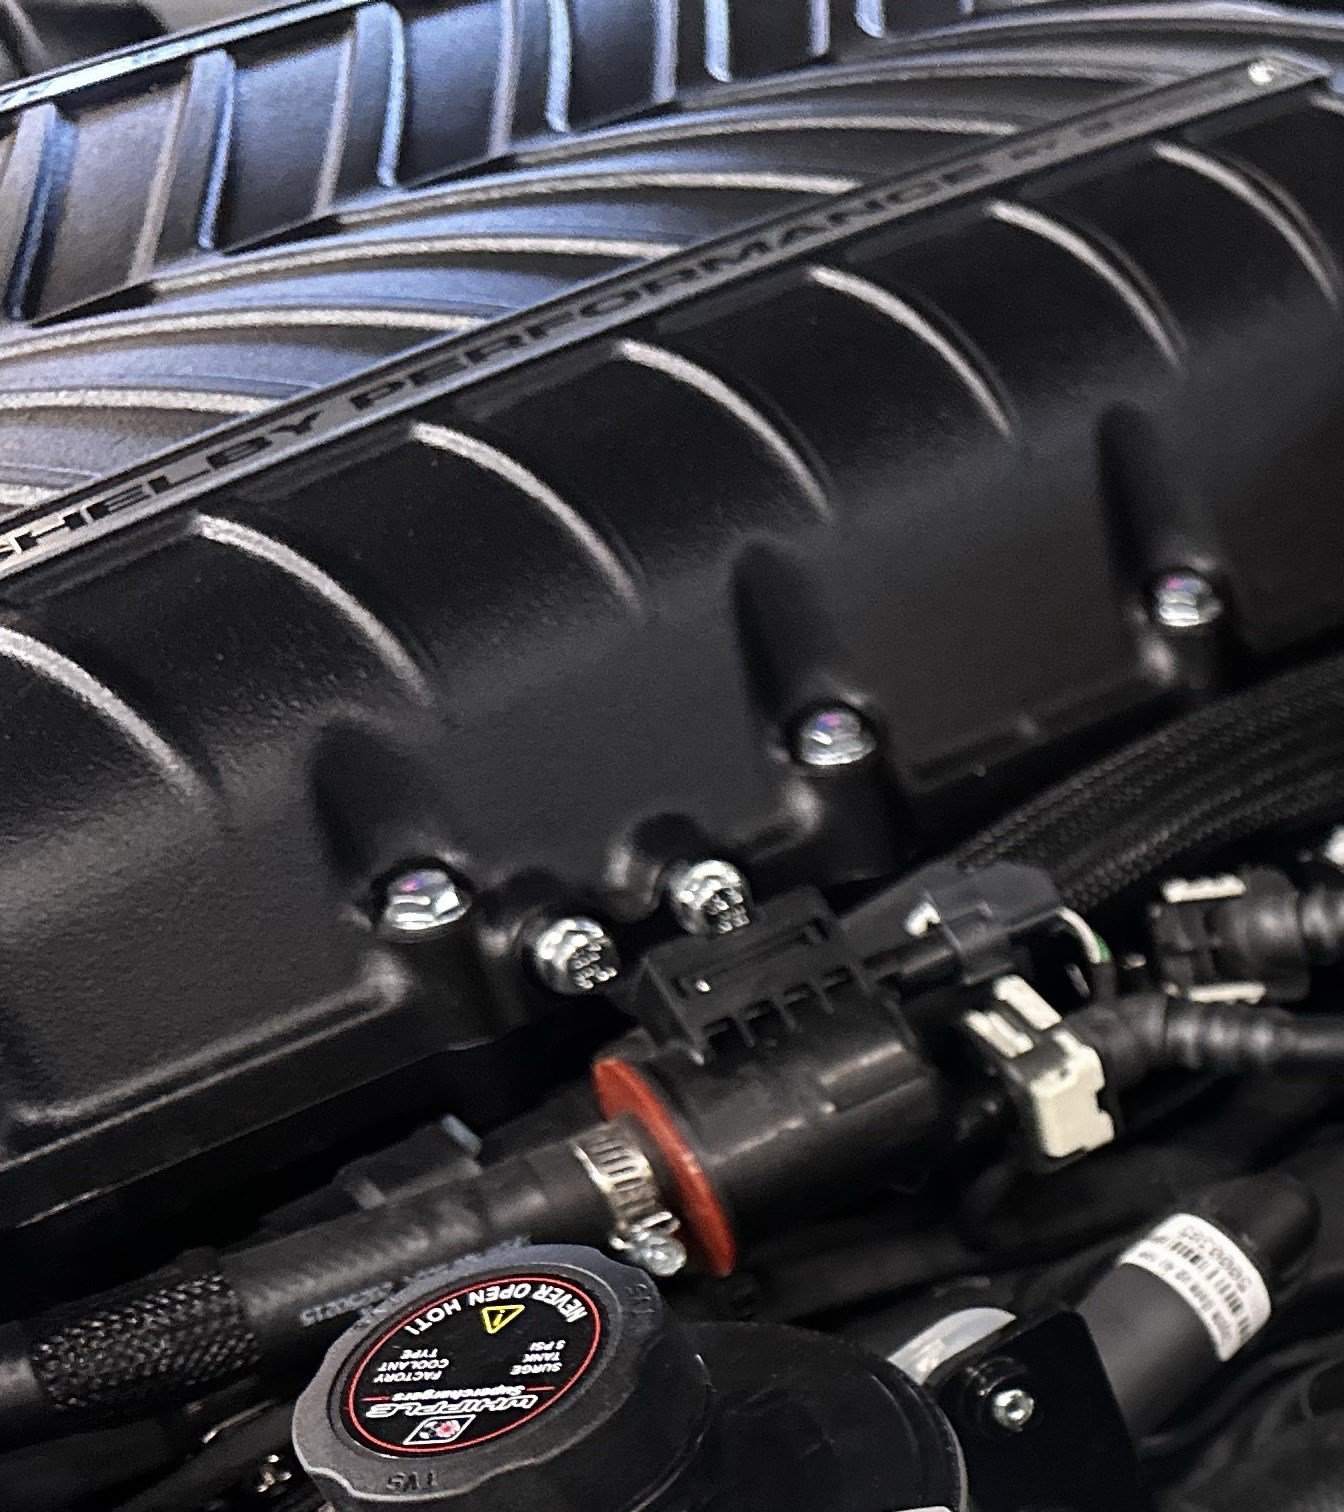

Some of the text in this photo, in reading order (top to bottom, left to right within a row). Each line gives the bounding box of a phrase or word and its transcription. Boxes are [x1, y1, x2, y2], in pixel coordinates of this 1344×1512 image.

[351, 161, 990, 412] PERFORMANCE
[468, 1283, 531, 1307] OPEN
[531, 1283, 588, 1323] NEVER
[403, 1301, 462, 1336] HOT!
[400, 1348, 438, 1360] TYPE
[522, 1351, 561, 1363] TANK
[377, 1358, 450, 1372] COOLANT
[509, 1362, 563, 1376] SURGE
[373, 1370, 443, 1384] FACTORY
[391, 1385, 526, 1402] Superchargers
[365, 1394, 539, 1418] WHIPPLE
